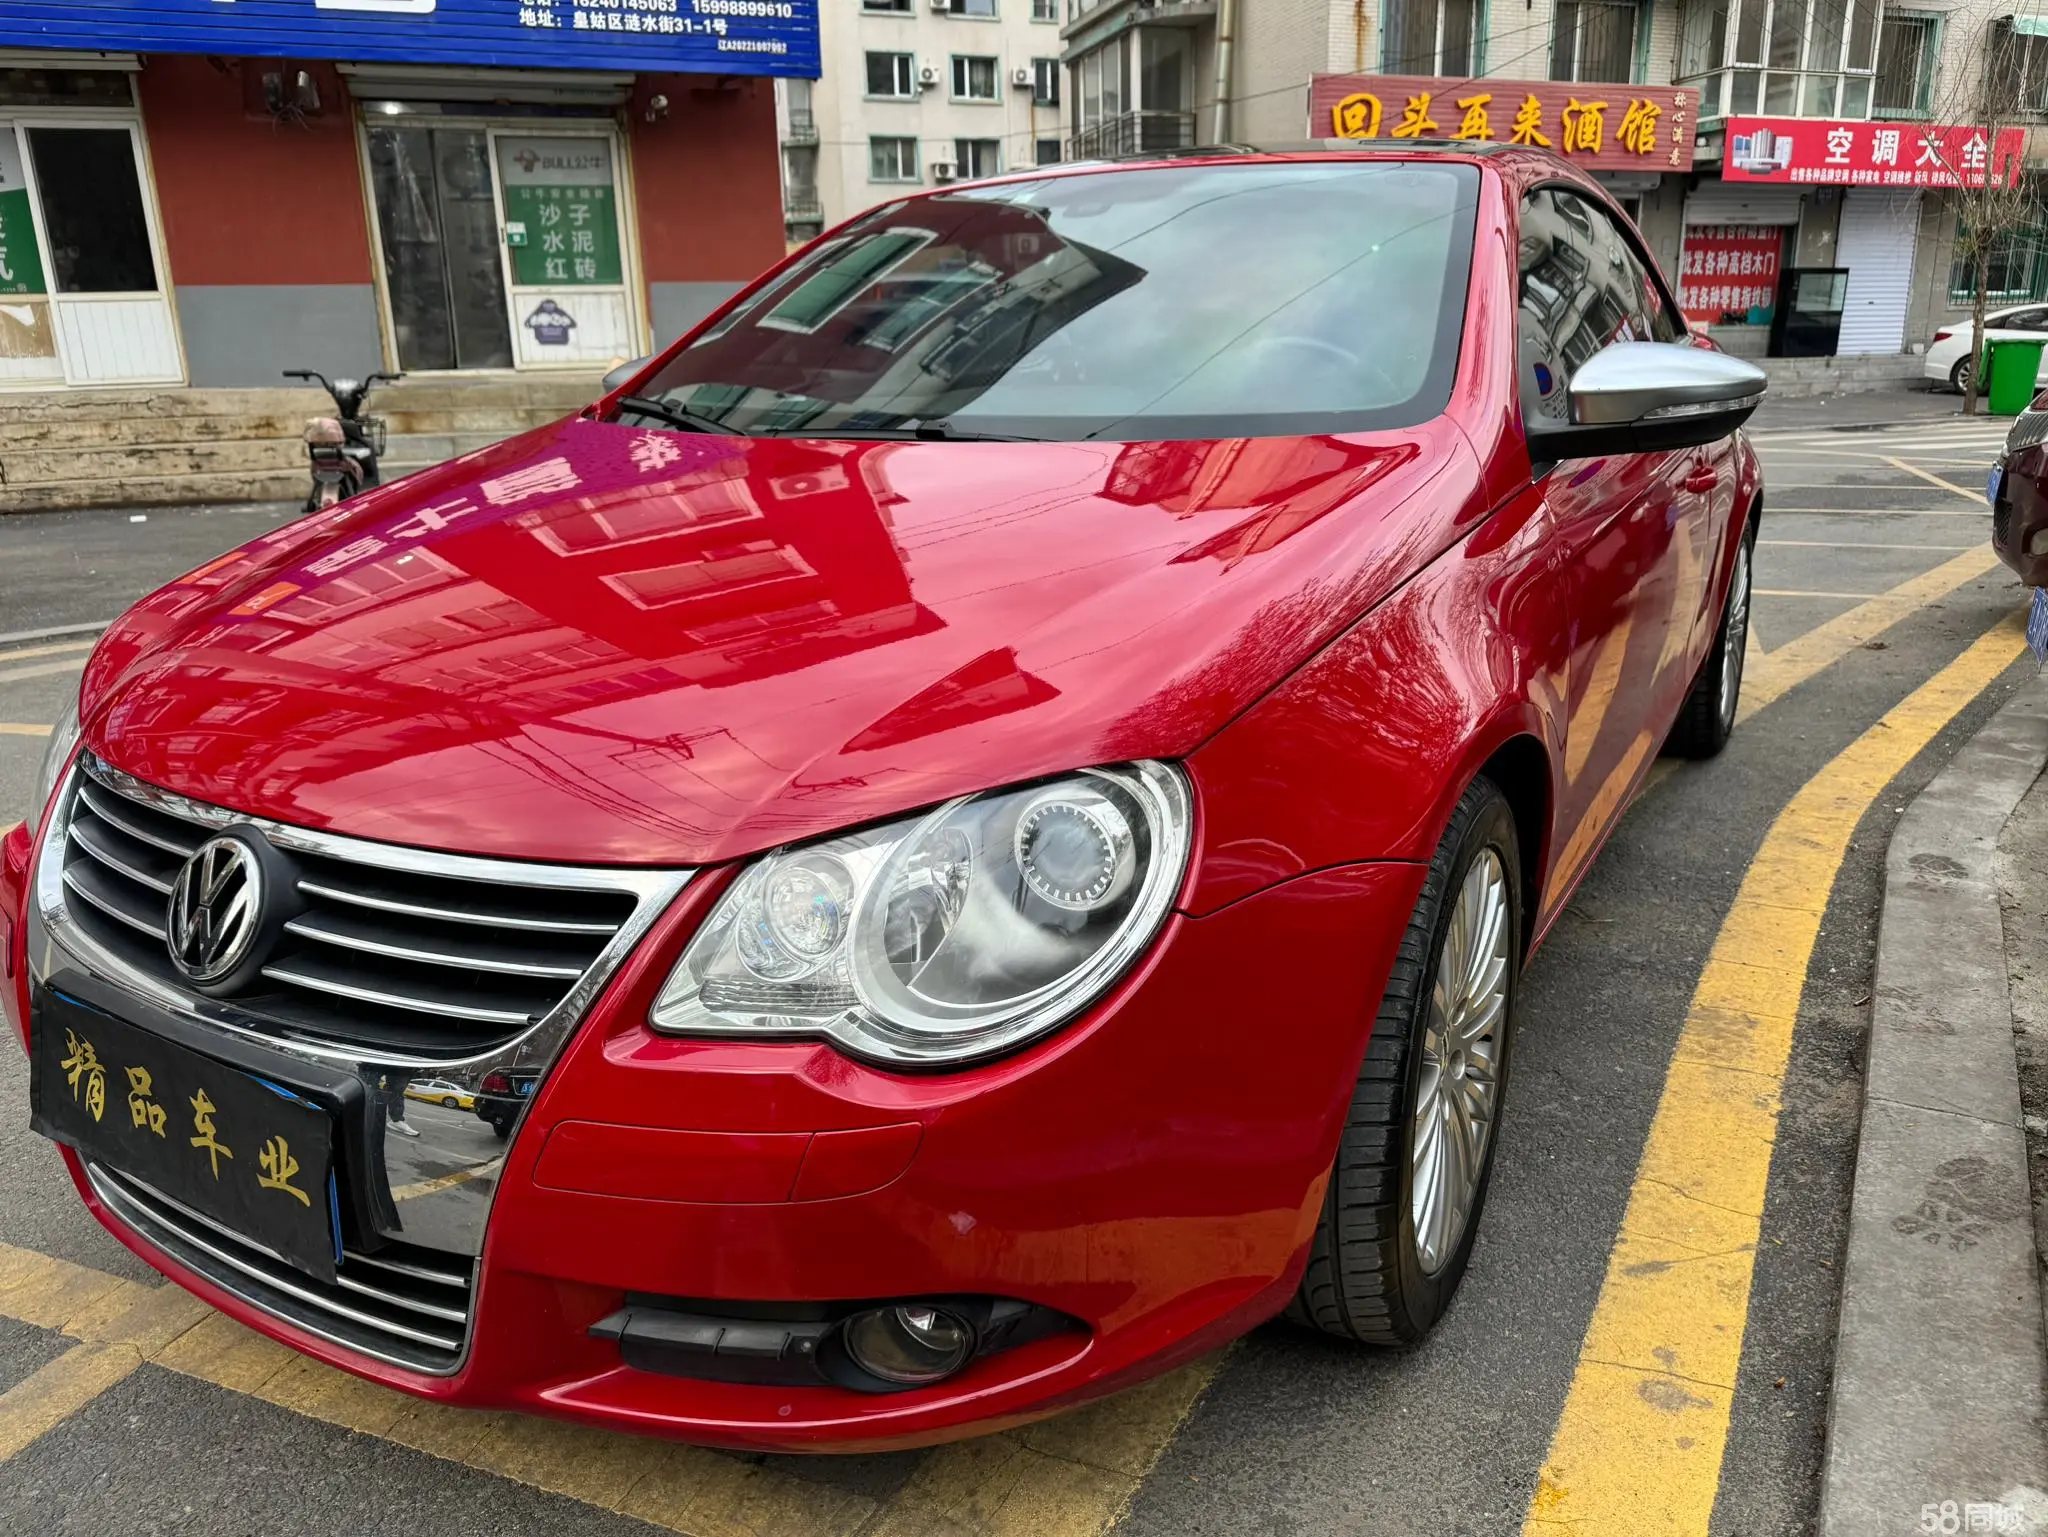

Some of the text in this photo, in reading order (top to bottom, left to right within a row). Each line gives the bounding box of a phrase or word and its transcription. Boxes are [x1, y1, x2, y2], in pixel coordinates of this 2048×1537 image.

[692, 0, 792, 18] 15998899610
[1332, 91, 1663, 155] 回头再来酒馆
[1825, 128, 1989, 168] 空调大全
[539, 204, 590, 227] 沙子
[543, 230, 594, 253] 水泥
[545, 257, 597, 279] 红砖
[60, 1027, 310, 1207] 精品车业
